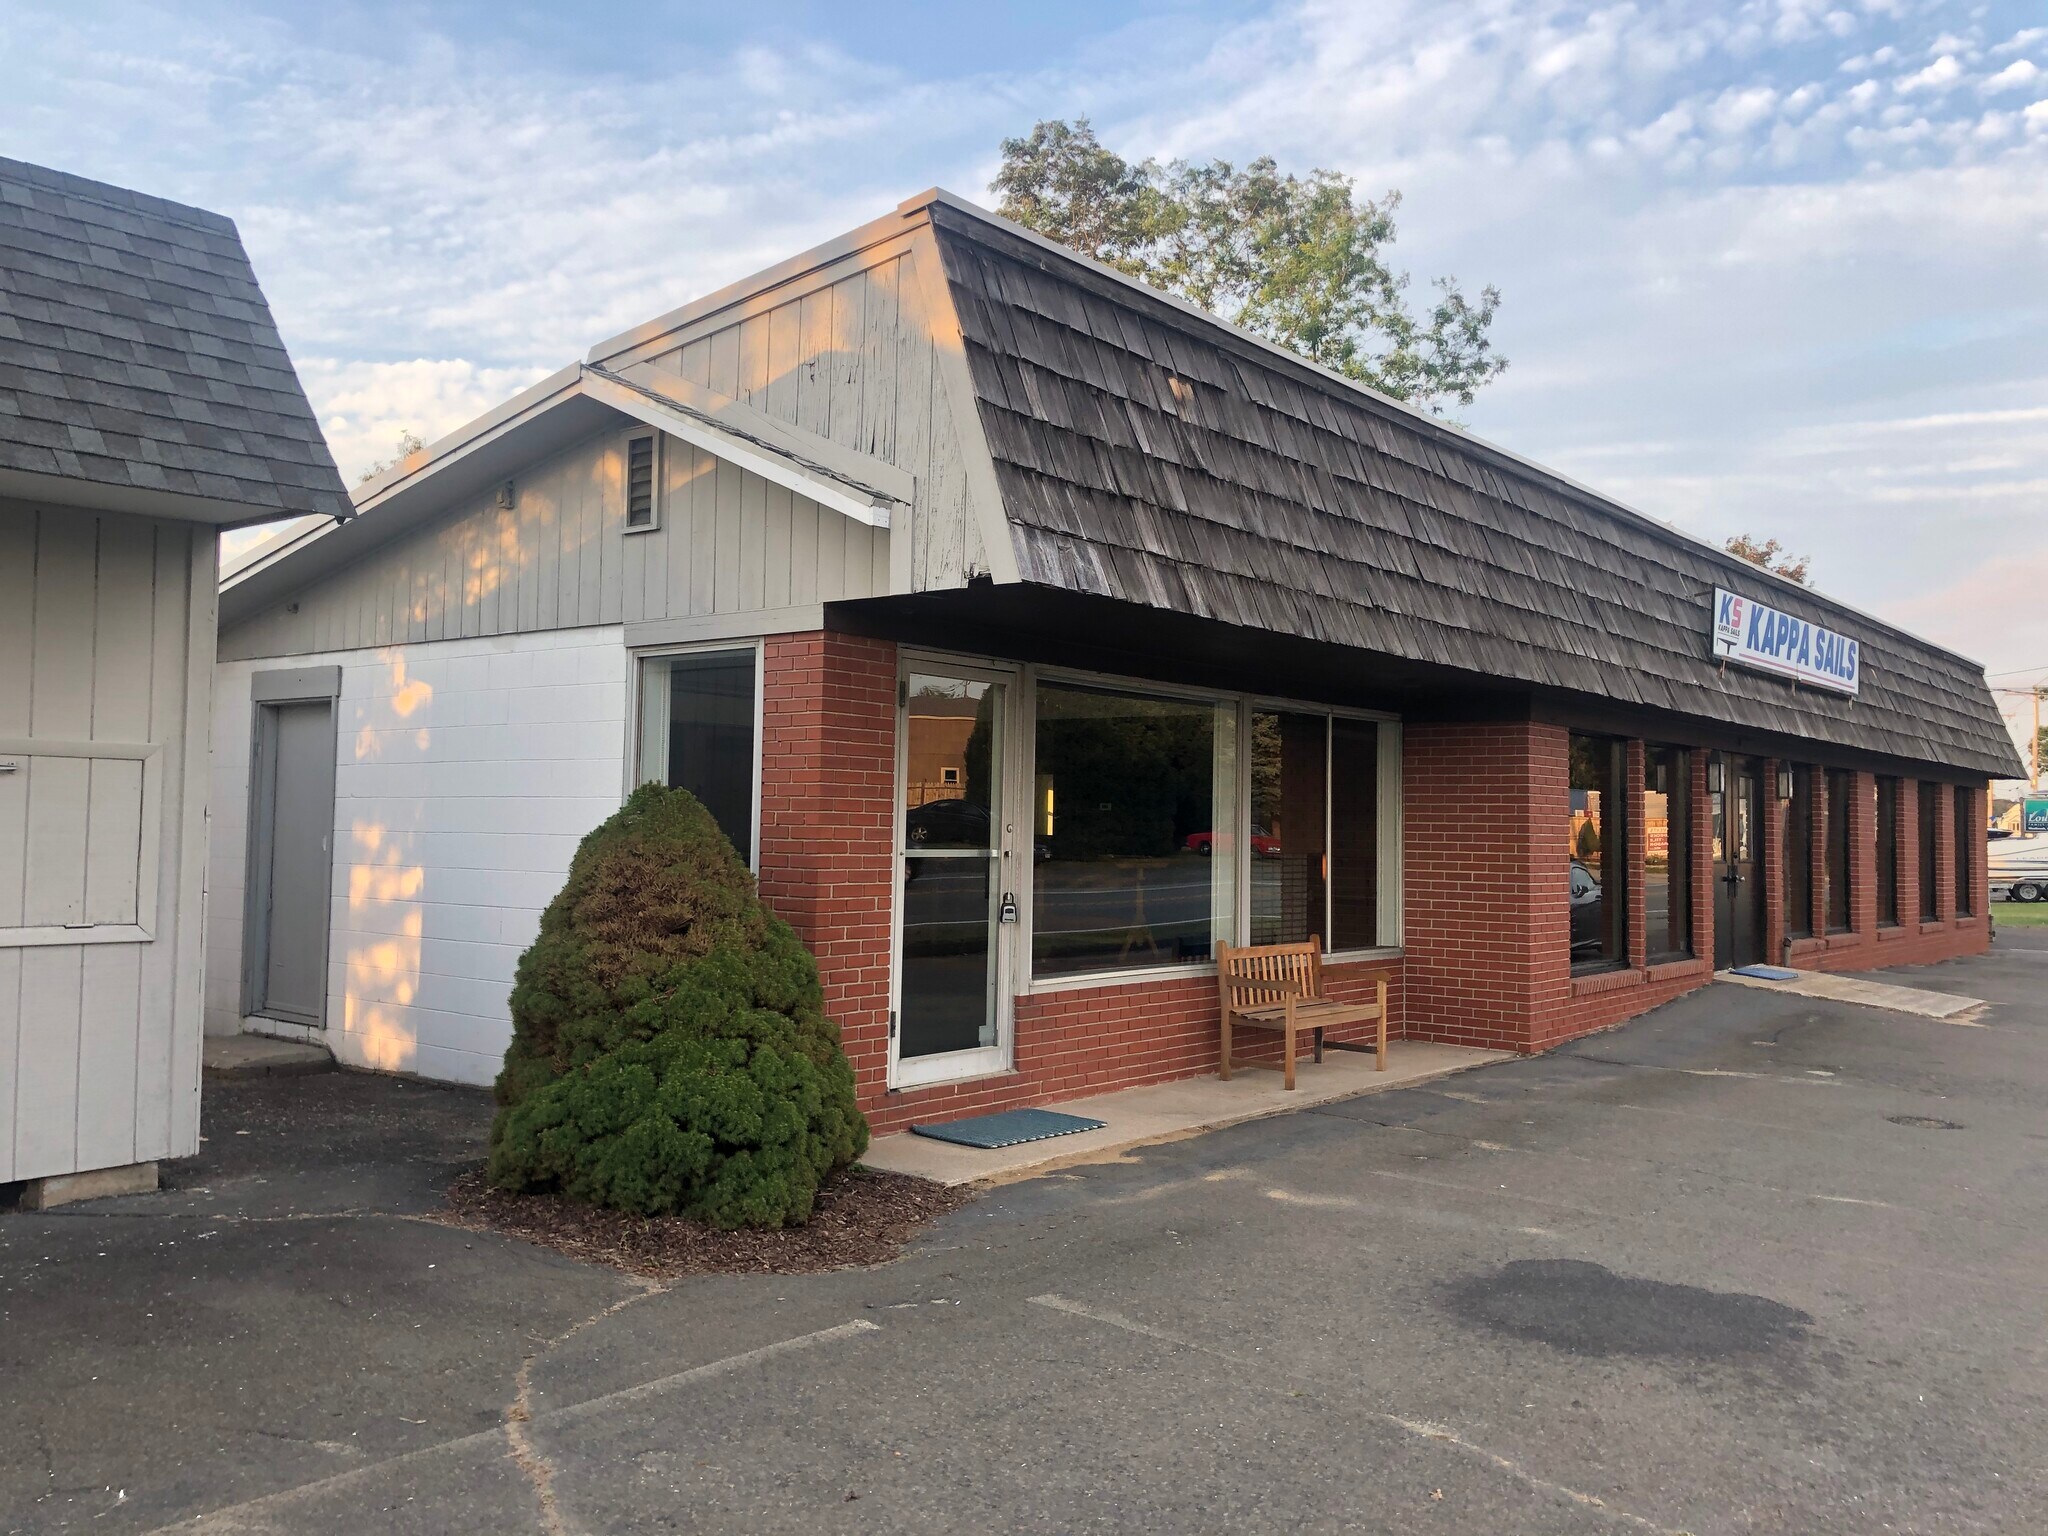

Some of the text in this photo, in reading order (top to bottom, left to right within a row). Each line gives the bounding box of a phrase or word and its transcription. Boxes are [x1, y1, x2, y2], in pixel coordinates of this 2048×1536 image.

[1719, 593, 1743, 628] KS
[1718, 624, 1740, 637] KAPPA SAILS
[1746, 604, 1857, 681] KAPPA SAILS
